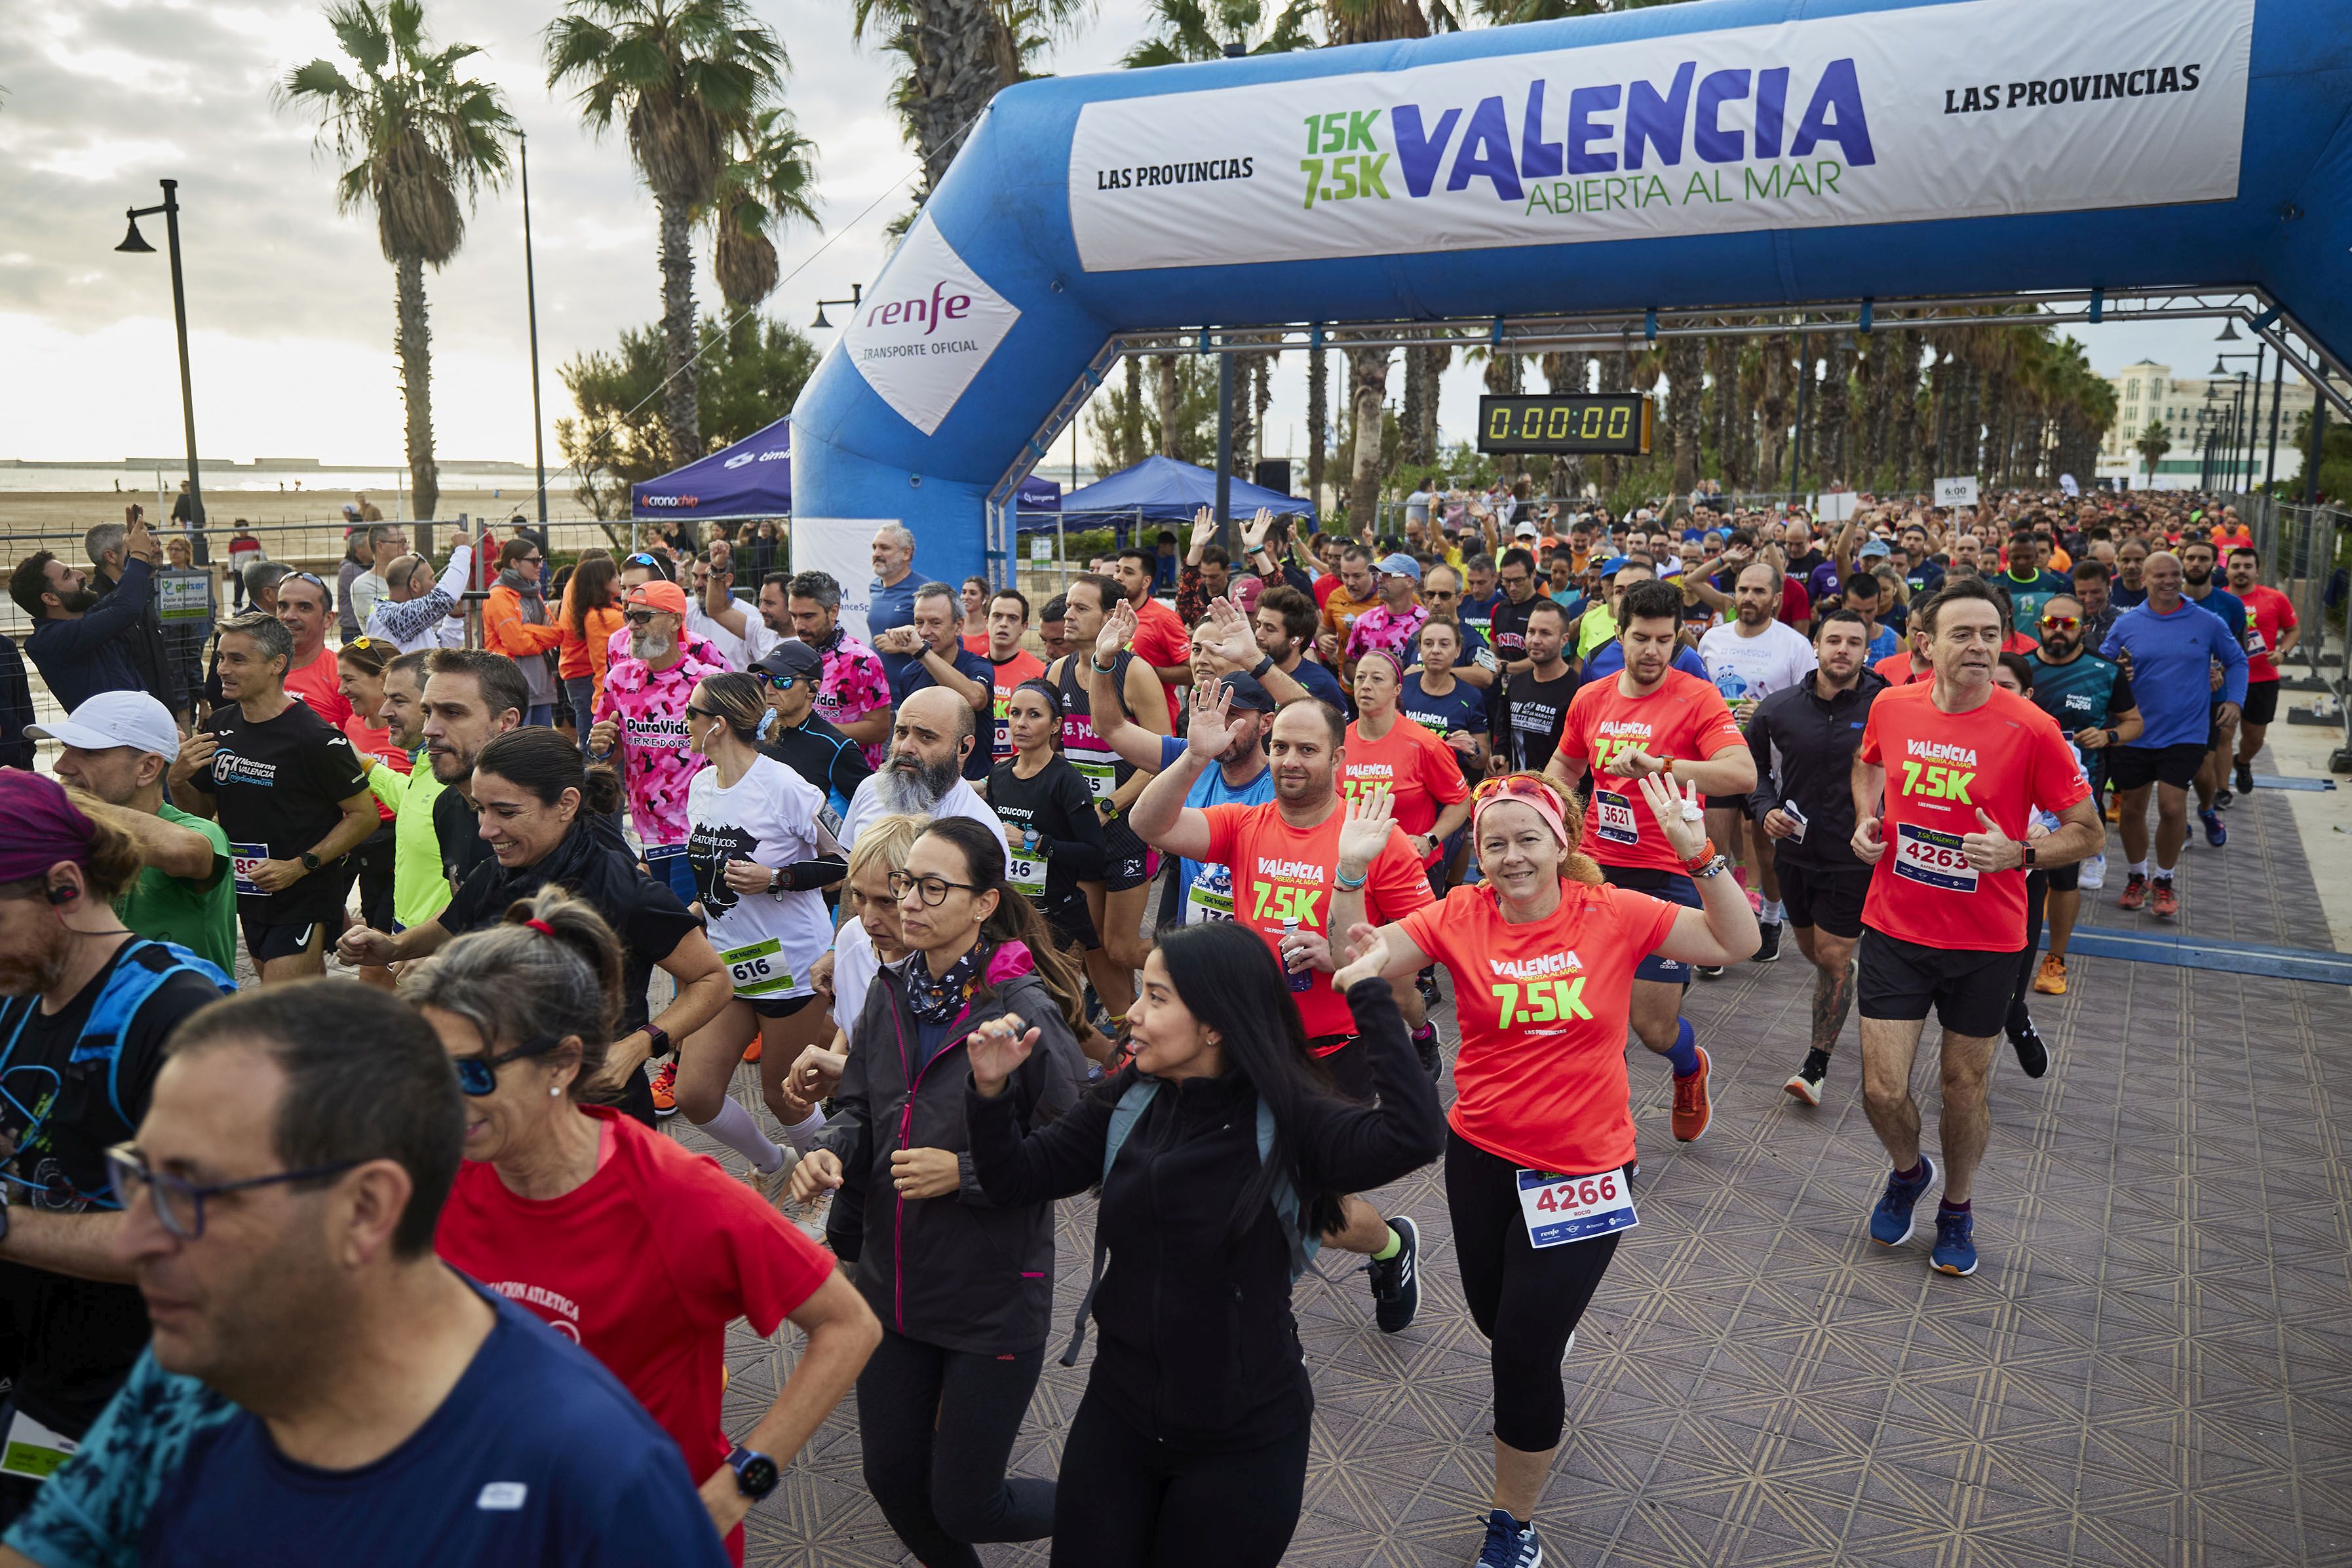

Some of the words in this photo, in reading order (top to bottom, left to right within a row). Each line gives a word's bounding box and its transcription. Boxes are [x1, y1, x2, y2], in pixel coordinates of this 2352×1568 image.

[1944, 85, 1999, 115] LAS
[2006, 63, 2201, 109] PROVINCIAS
[1303, 108, 1382, 155] 15K
[1391, 58, 1876, 201] VALENCIA
[1097, 168, 1132, 190] LAS
[1136, 157, 1253, 187] PROVINCIAS
[1300, 153, 1391, 210] 7.5K
[1526, 175, 1672, 216] ABIERTA
[1682, 169, 1733, 205] AL
[1745, 160, 1841, 201] MAR
[866, 280, 971, 335] renfe
[863, 344, 926, 360] TRANSPORTE
[931, 339, 978, 354] OFICIAL
[649, 494, 699, 508] cronochip
[1406, 710, 1448, 727] VALENCIA
[1535, 704, 1556, 715] 2016
[1600, 721, 1651, 738] VALENCIA
[1907, 738, 1977, 767] VALENCIA
[1924, 756, 1946, 765] ABIERTA
[214, 754, 243, 781] 15K
[239, 765, 274, 778] VALENCIA
[241, 757, 277, 771] Nocturna
[1345, 763, 1394, 778] VALENCIA
[229, 774, 273, 787] mediolanum
[1902, 760, 1976, 805] 7.5K
[997, 805, 1034, 820] saucony
[1604, 806, 1630, 826] 3621
[1917, 831, 1931, 841] 7.5K
[1931, 834, 1959, 847] VALENCIA
[1906, 841, 1969, 870] 4263
[1258, 857, 1324, 883] VALENCIA
[1274, 875, 1295, 884] ABIERTA
[1204, 895, 1214, 905] 15K
[1252, 881, 1322, 927] 7.5K
[739, 947, 762, 957] VALENCIA
[733, 958, 771, 981] 616
[1490, 950, 1583, 978] VALENCIA
[1519, 973, 1549, 982] ABIERTA
[1549, 969, 1560, 978] AL
[1560, 966, 1578, 976] MAR
[1492, 976, 1594, 1029] 7.5K
[1536, 1176, 1616, 1213] 4266
[1540, 1228, 1560, 1237] renfe
[525, 1285, 580, 1322] ATLETICA
